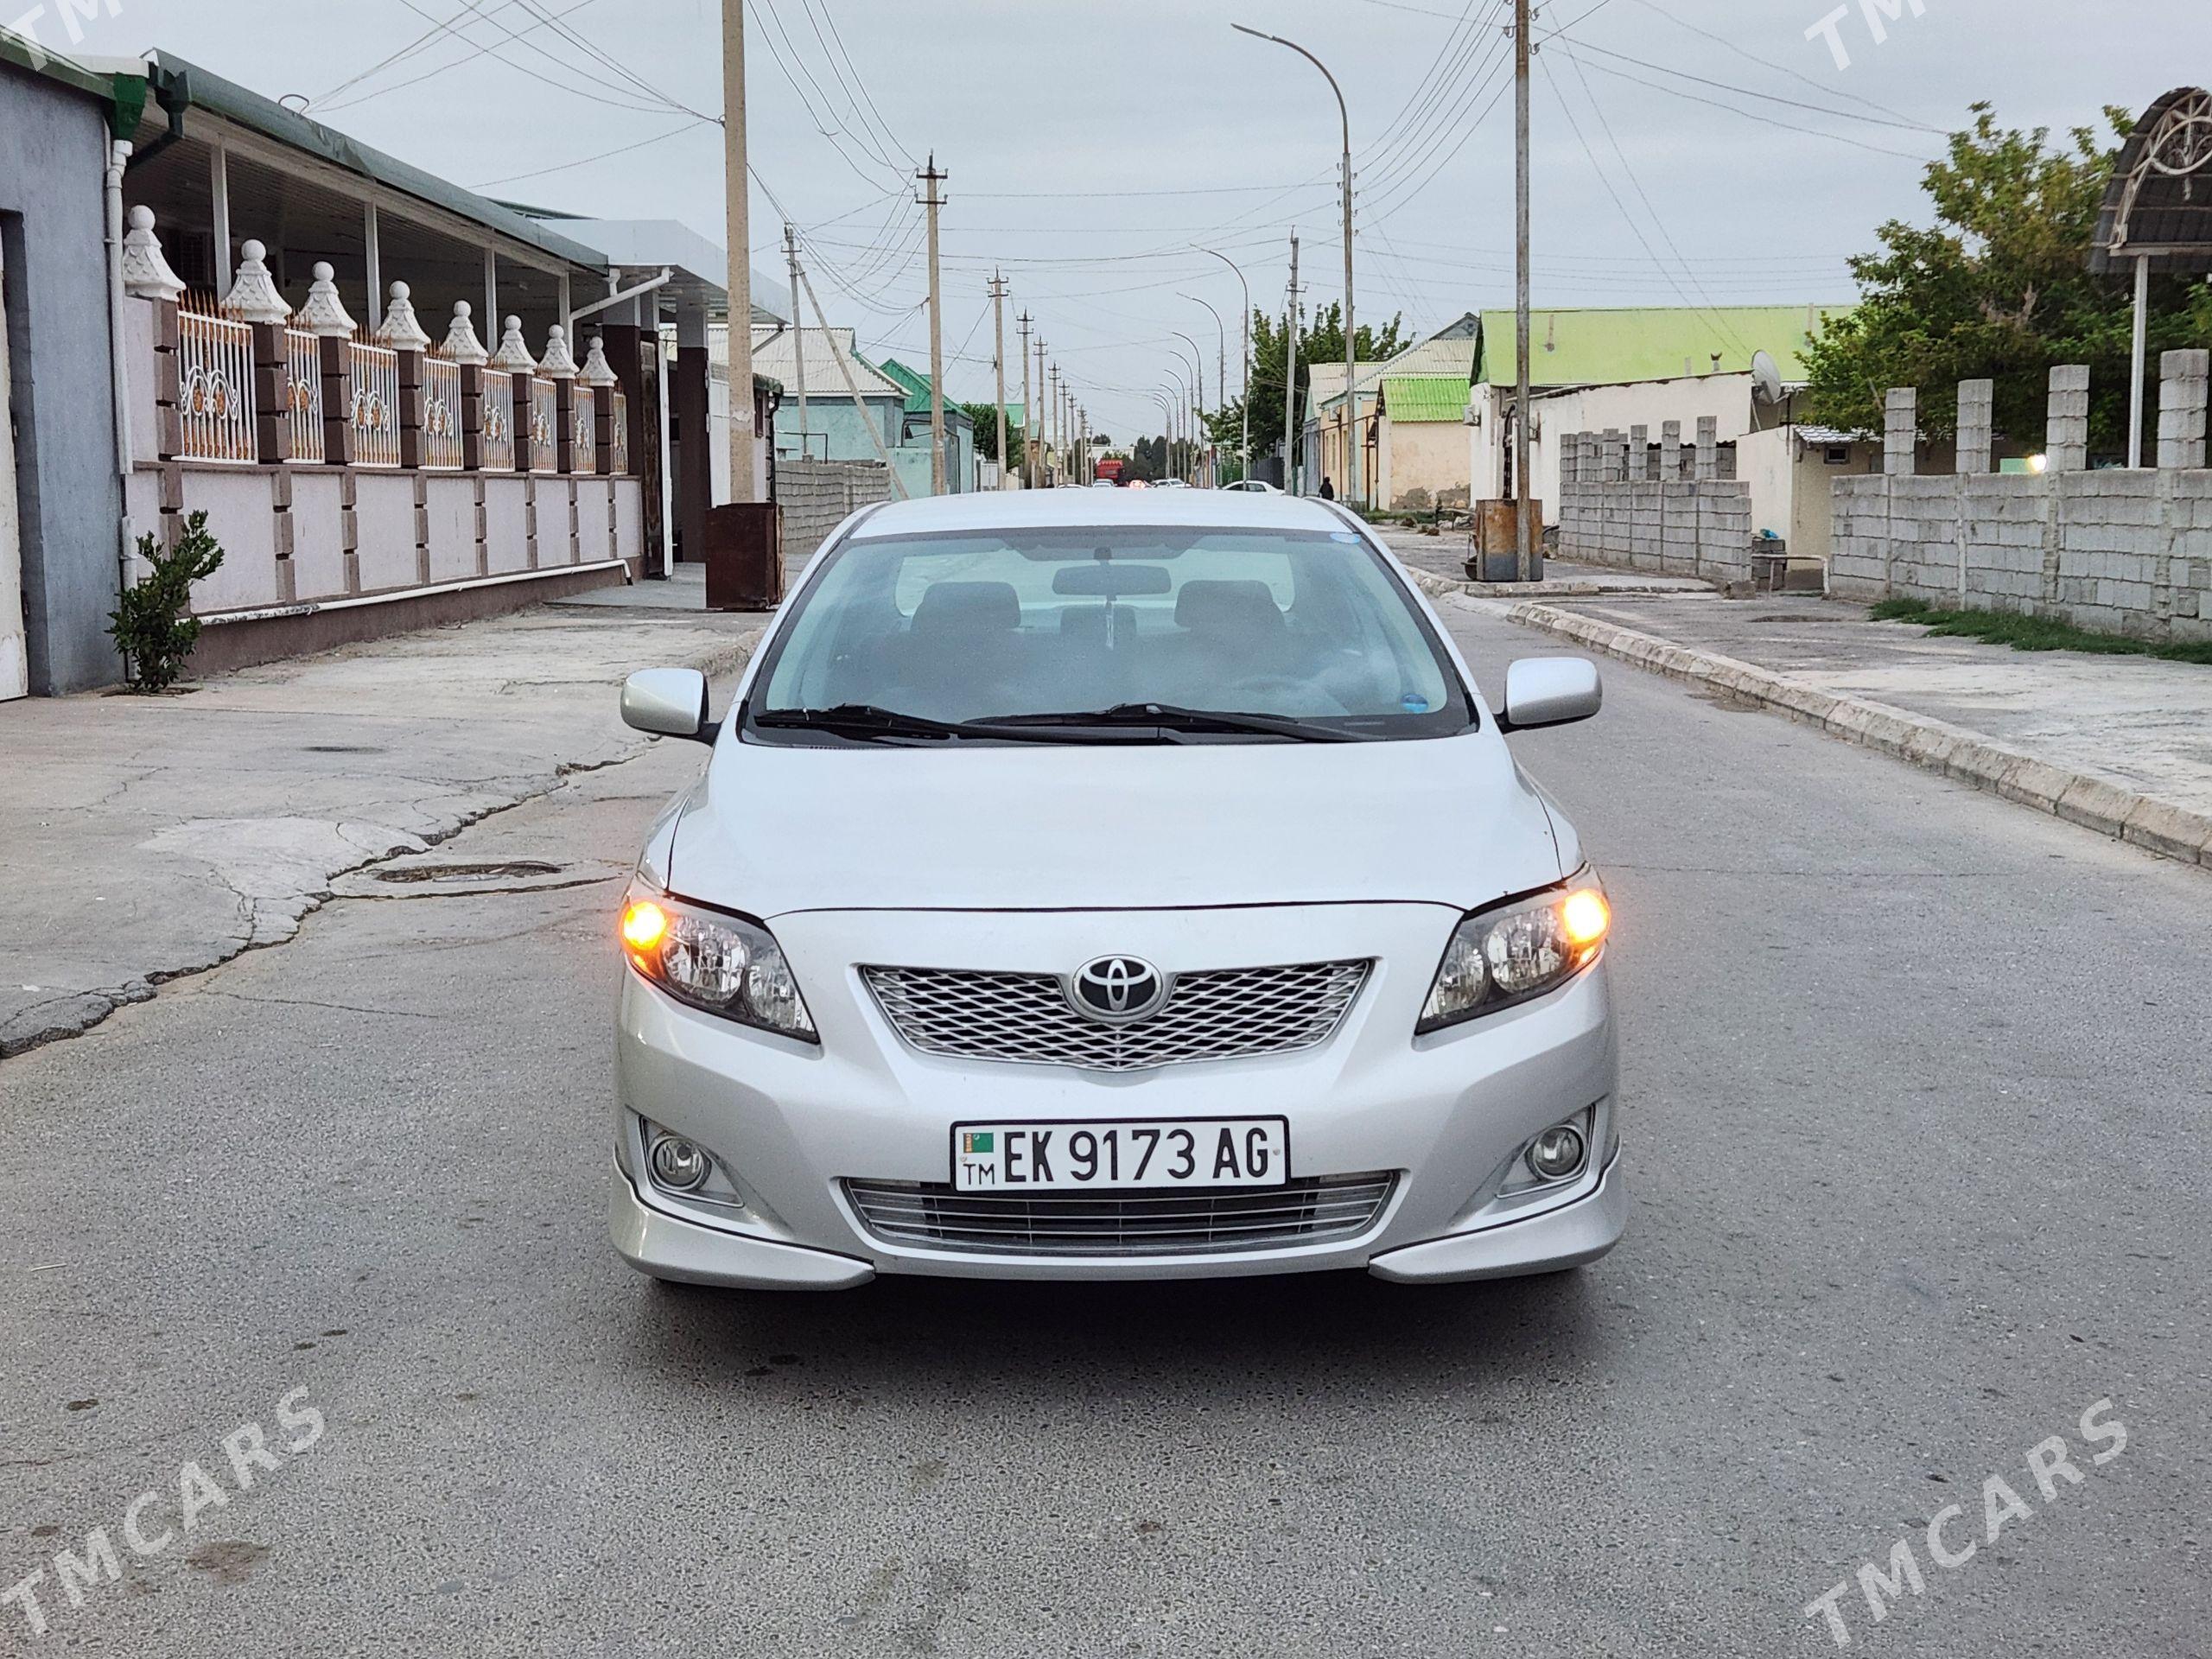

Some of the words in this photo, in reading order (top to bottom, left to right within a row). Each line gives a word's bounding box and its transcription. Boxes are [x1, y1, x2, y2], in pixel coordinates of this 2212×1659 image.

[963, 1163, 995, 1185] TM
[1003, 1130, 1054, 1183] EK
[1069, 1128, 1196, 1181] 9173
[1212, 1127, 1268, 1179] AG
